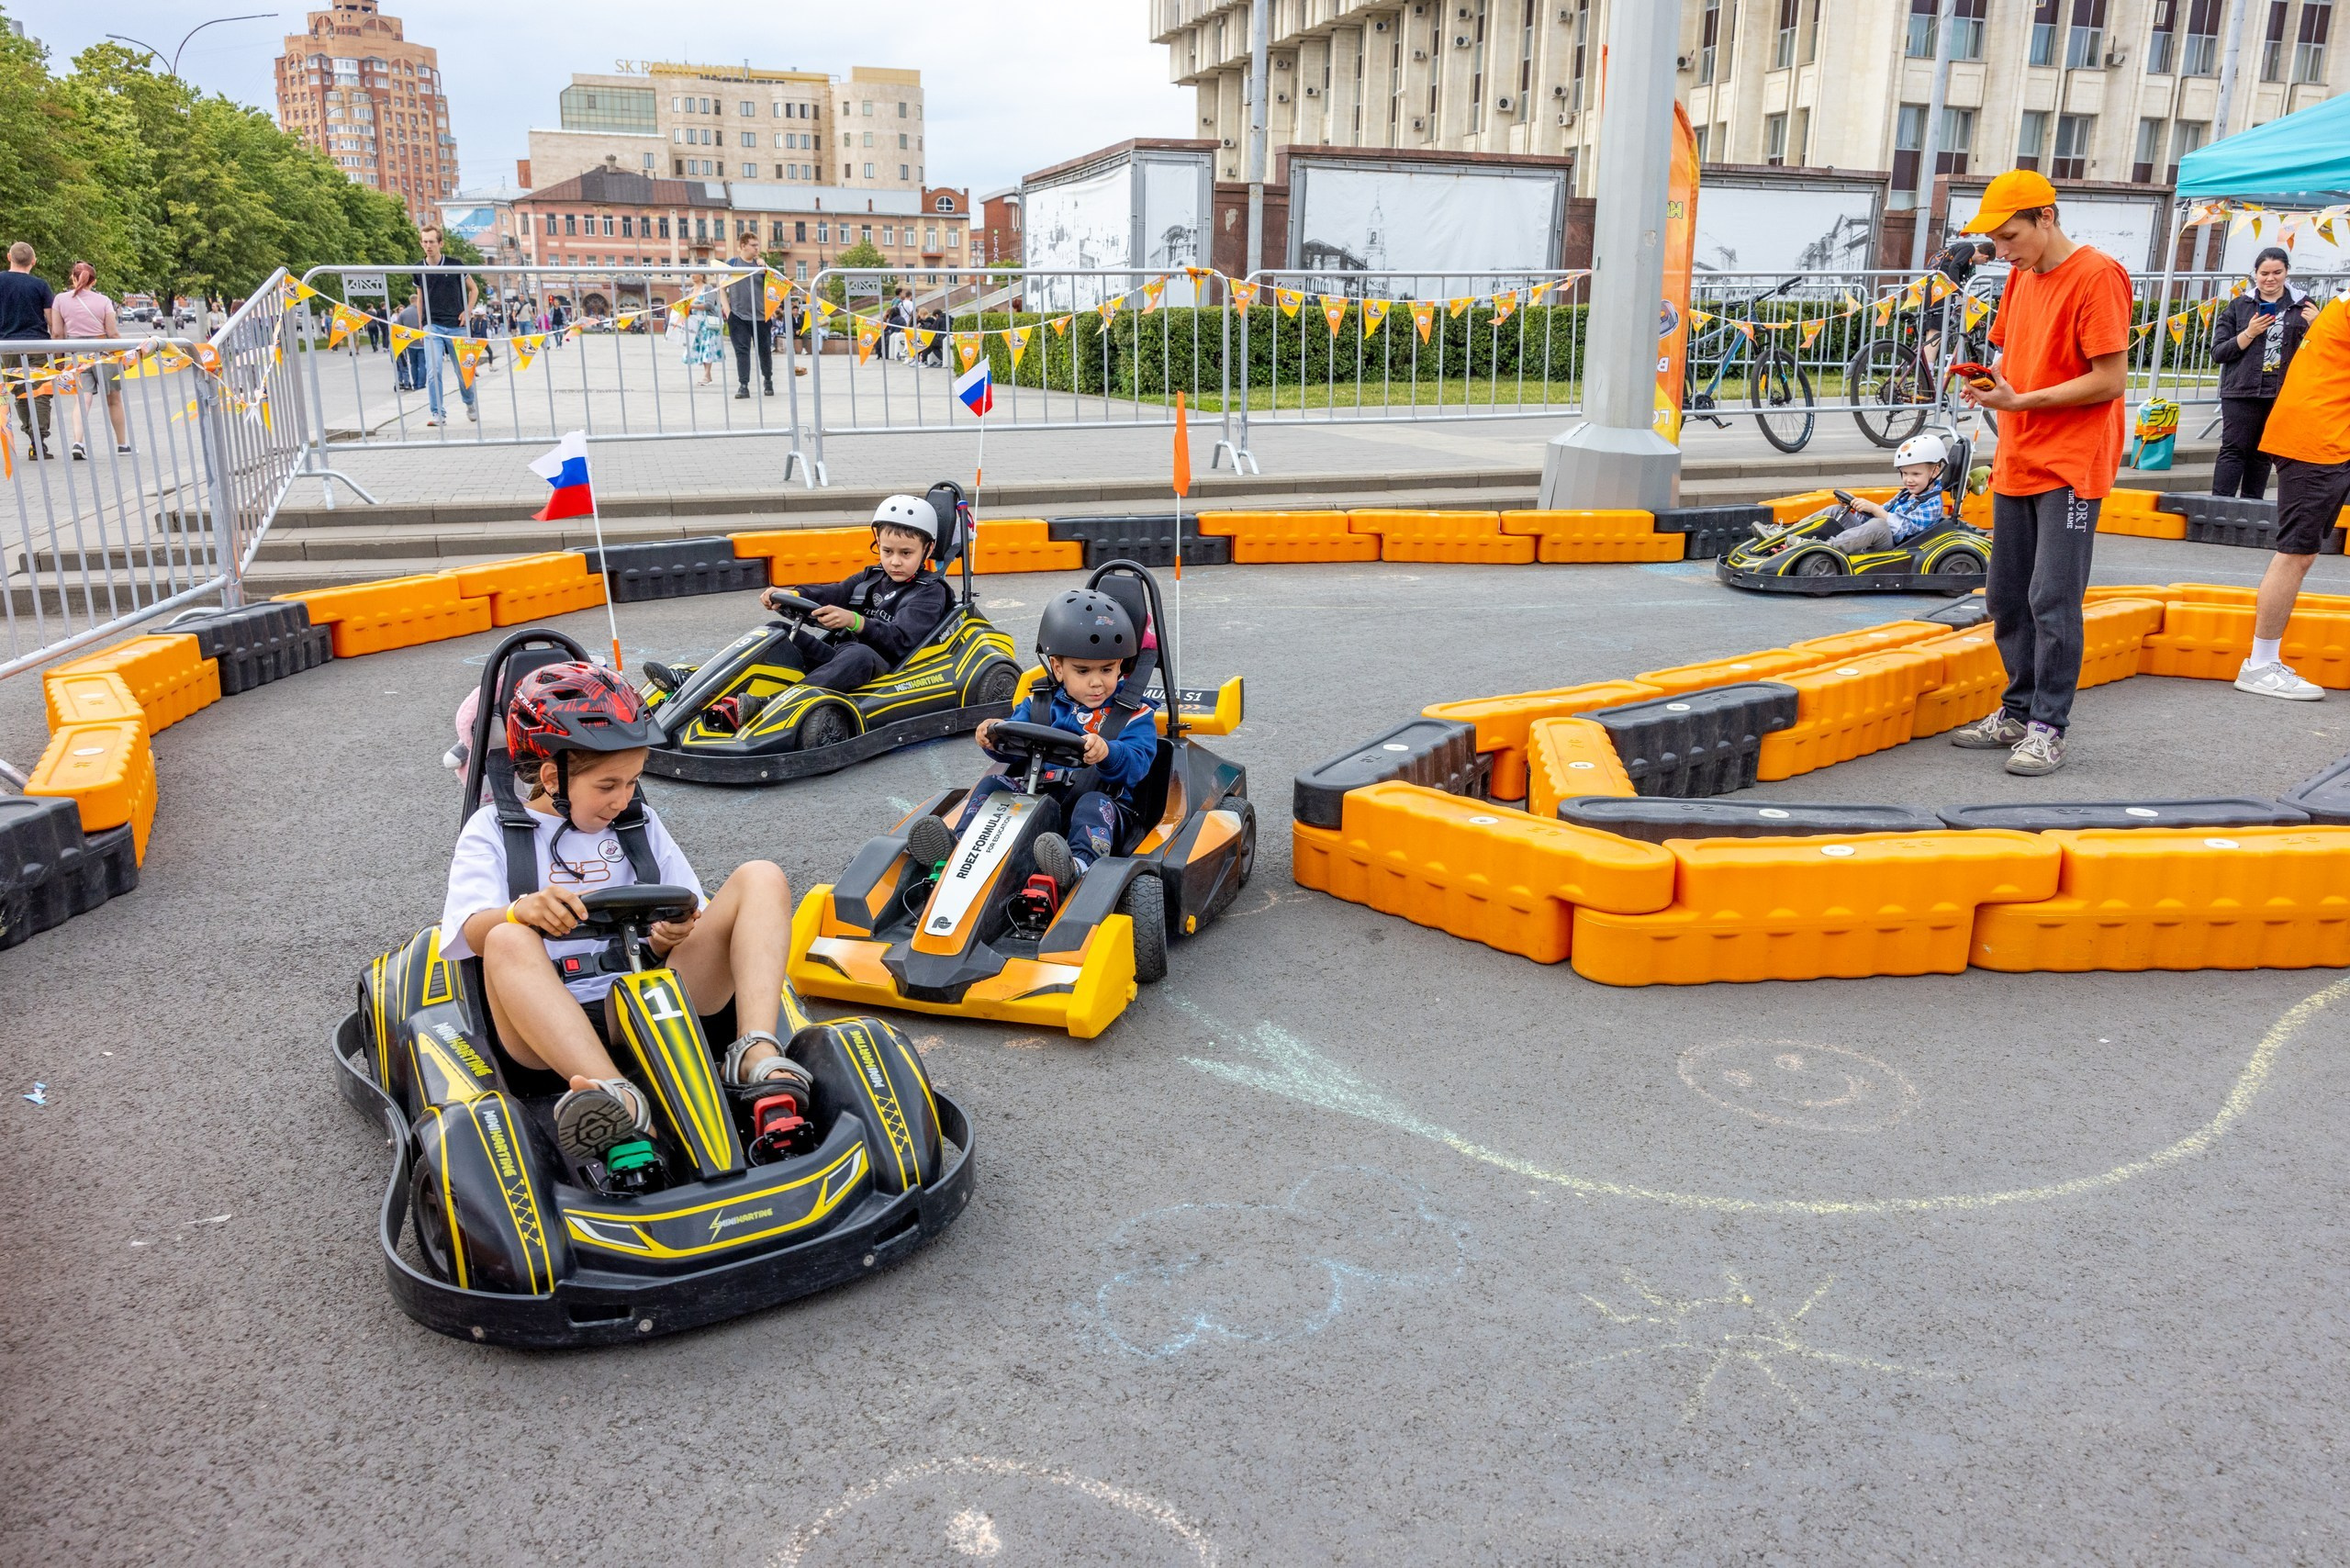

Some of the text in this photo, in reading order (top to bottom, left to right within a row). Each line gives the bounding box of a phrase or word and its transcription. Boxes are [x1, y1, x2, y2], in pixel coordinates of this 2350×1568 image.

[615, 59, 636, 73] SK
[2074, 499, 2089, 533] ORT
[1183, 691, 1203, 701] S1
[956, 802, 1010, 879] RIDEZ FORMULA S1
[986, 815, 1012, 854] FOR EDUCATION
[643, 986, 683, 1022] 1
